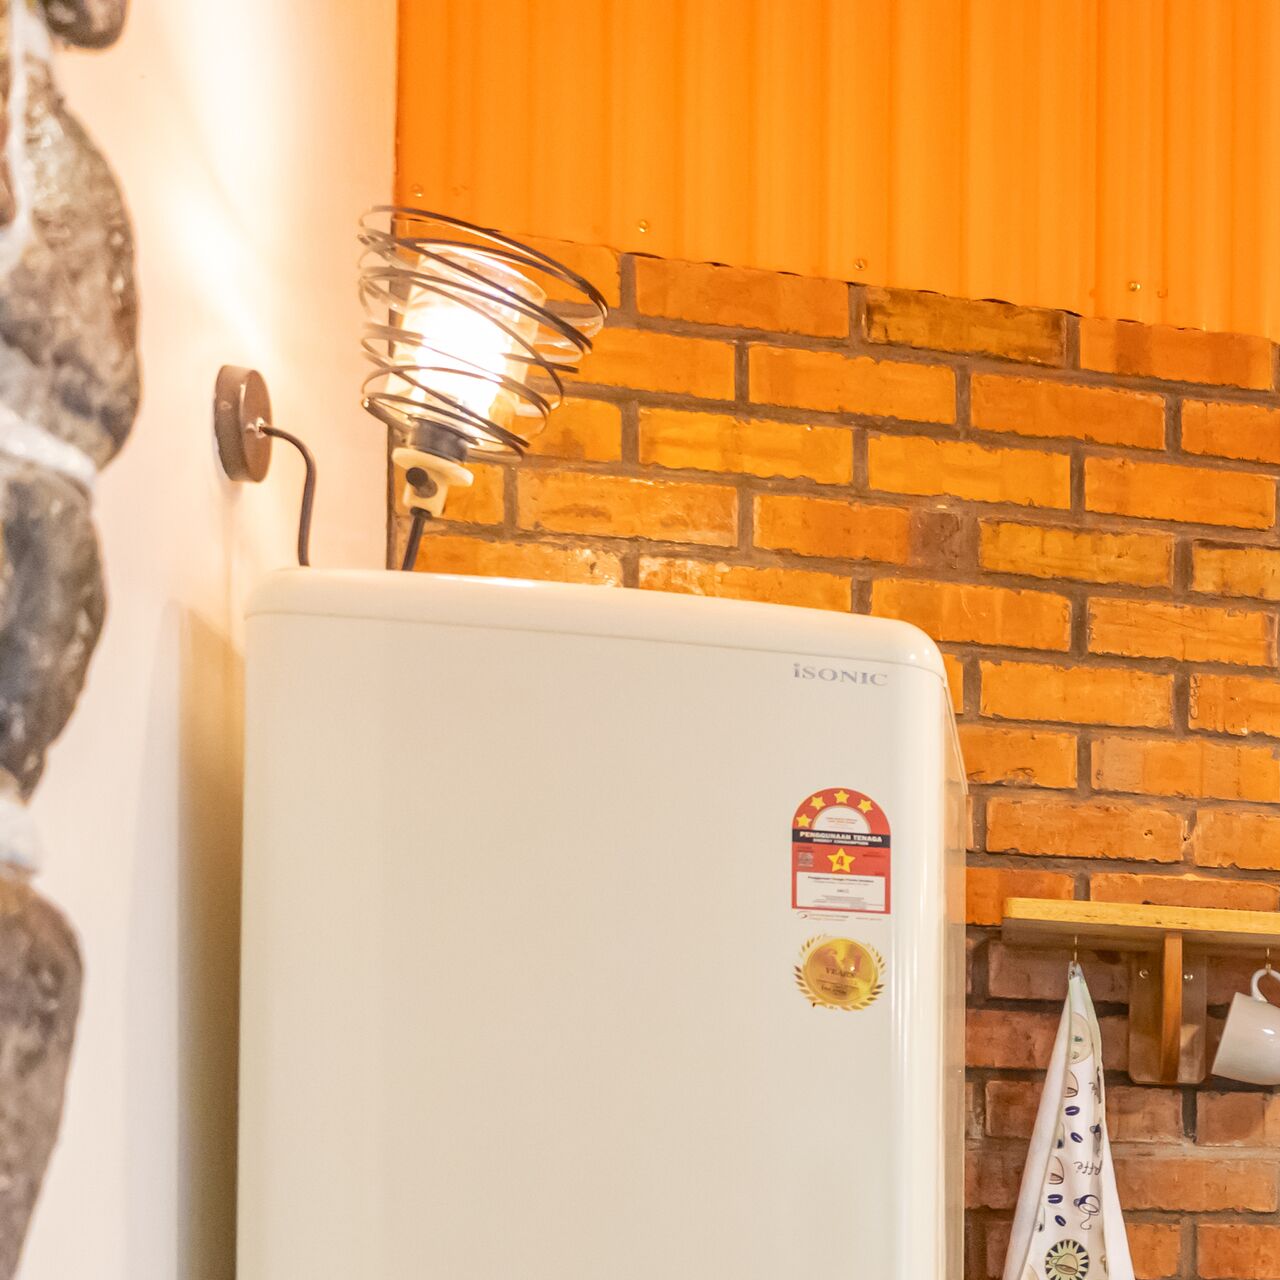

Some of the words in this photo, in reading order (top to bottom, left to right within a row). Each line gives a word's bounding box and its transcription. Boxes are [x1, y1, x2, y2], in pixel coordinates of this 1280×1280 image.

[793, 663, 888, 686] iSONIC
[853, 834, 882, 843] TENAGA
[836, 855, 845, 866] 4
